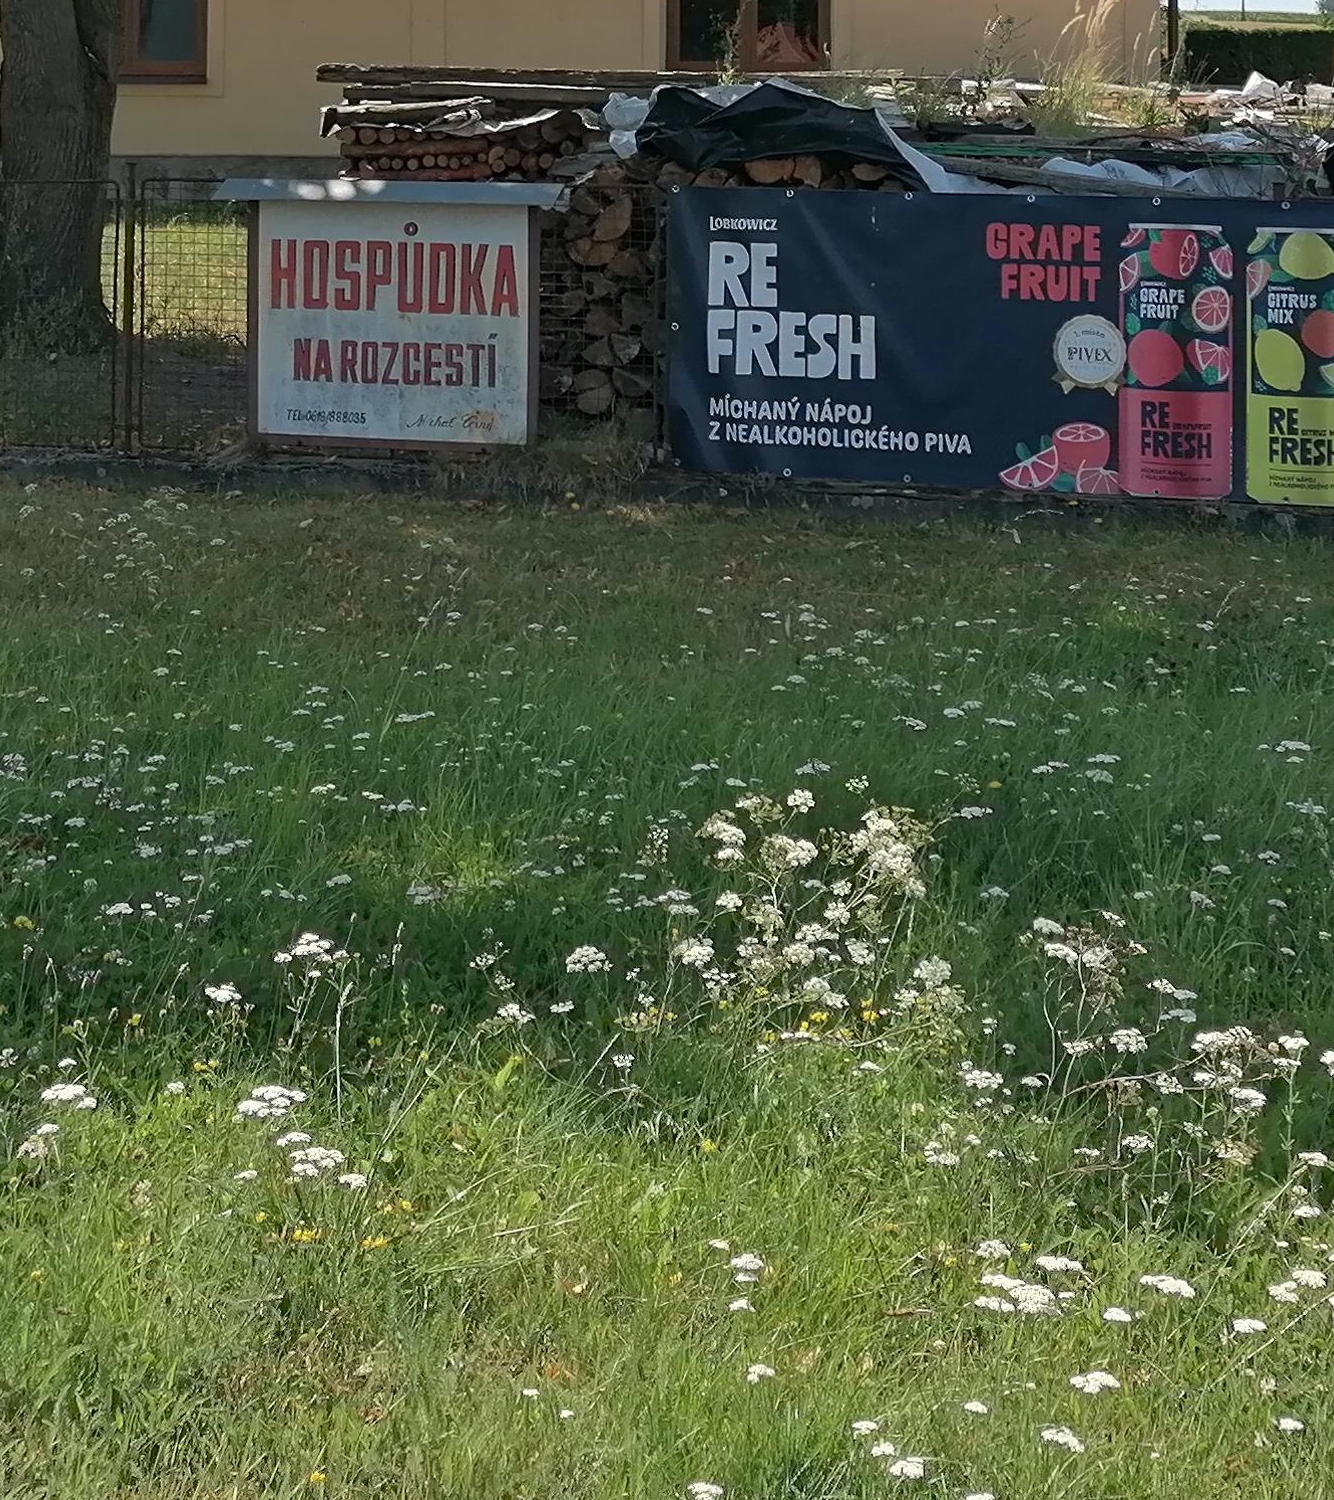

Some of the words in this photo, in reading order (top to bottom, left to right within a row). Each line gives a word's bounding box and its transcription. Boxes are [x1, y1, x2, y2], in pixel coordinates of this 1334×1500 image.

[709, 216, 778, 231] LOBKOWICZ
[986, 222, 1101, 261] GRAPE
[270, 221, 521, 318] HOSPŮDKA
[707, 241, 778, 307] RE
[1001, 263, 1101, 302] FRUIT
[1139, 288, 1185, 304] GRAPE
[1139, 303, 1179, 319] FRUIT
[1267, 293, 1317, 309] CITRUS
[1267, 308, 1294, 324] MIX
[707, 309, 876, 380] FRESH
[1067, 347, 1114, 363] PIVEX
[292, 338, 334, 383] NA
[340, 332, 497, 388] ROZCESTÍ
[709, 393, 800, 421] MÍCHANÝ
[805, 398, 872, 425] NÁPOJ
[1141, 400, 1170, 429] RE
[1269, 407, 1299, 435] RE
[708, 421, 720, 441] Z
[725, 425, 919, 451] NEALKOHOLICKÉHO
[924, 433, 972, 455] PIVA
[1141, 429, 1212, 459] FRESH
